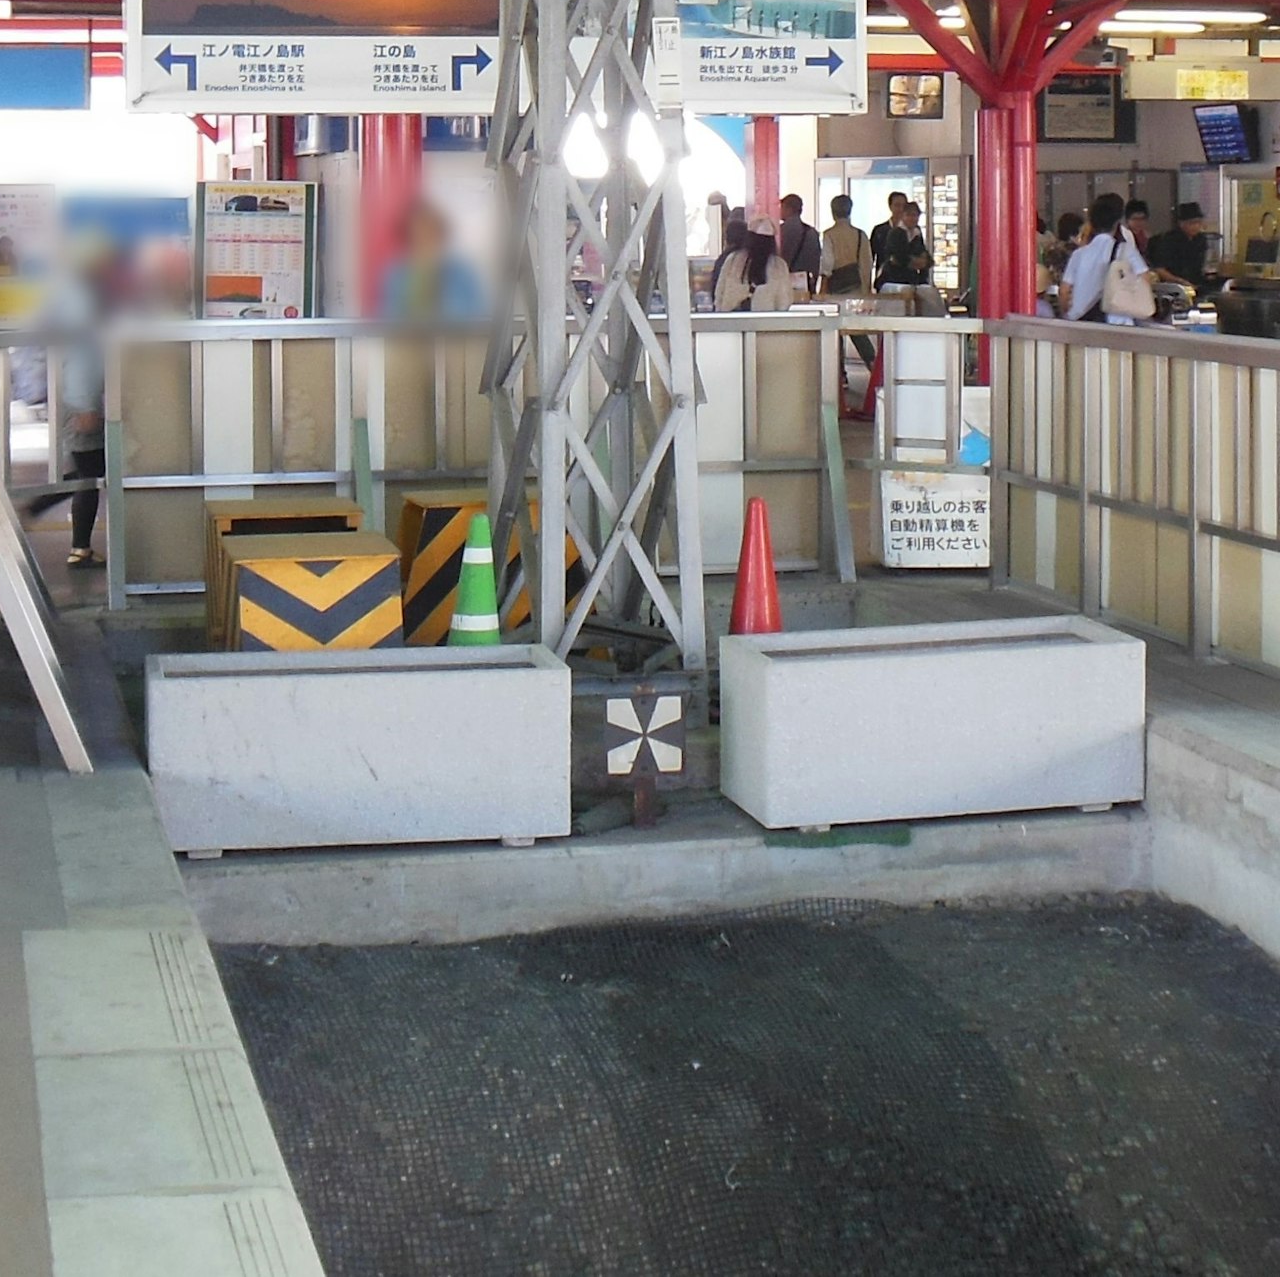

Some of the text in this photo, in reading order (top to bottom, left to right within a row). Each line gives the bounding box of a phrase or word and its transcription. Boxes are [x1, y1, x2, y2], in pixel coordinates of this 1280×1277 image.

[202, 43, 416, 59] 江ノ電江ノ島駅 江の島
[700, 45, 796, 61] 新江ノ島水族館
[238, 63, 438, 74] 弁天橋を渡って 弁天橋を渡って
[699, 65, 753, 75] 改札を出て右
[238, 73, 439, 84] つきあたりを左 つきあたりを右
[700, 75, 787, 84] Enoshima Aquarium
[204, 84, 239, 92] Enoden
[241, 84, 286, 92] Enoshima
[373, 84, 447, 93] Enoshima island
[890, 499, 988, 514] 乗り越しのお客
[890, 518, 980, 533] 自動精算機を
[890, 536, 988, 552] ご利用ください
